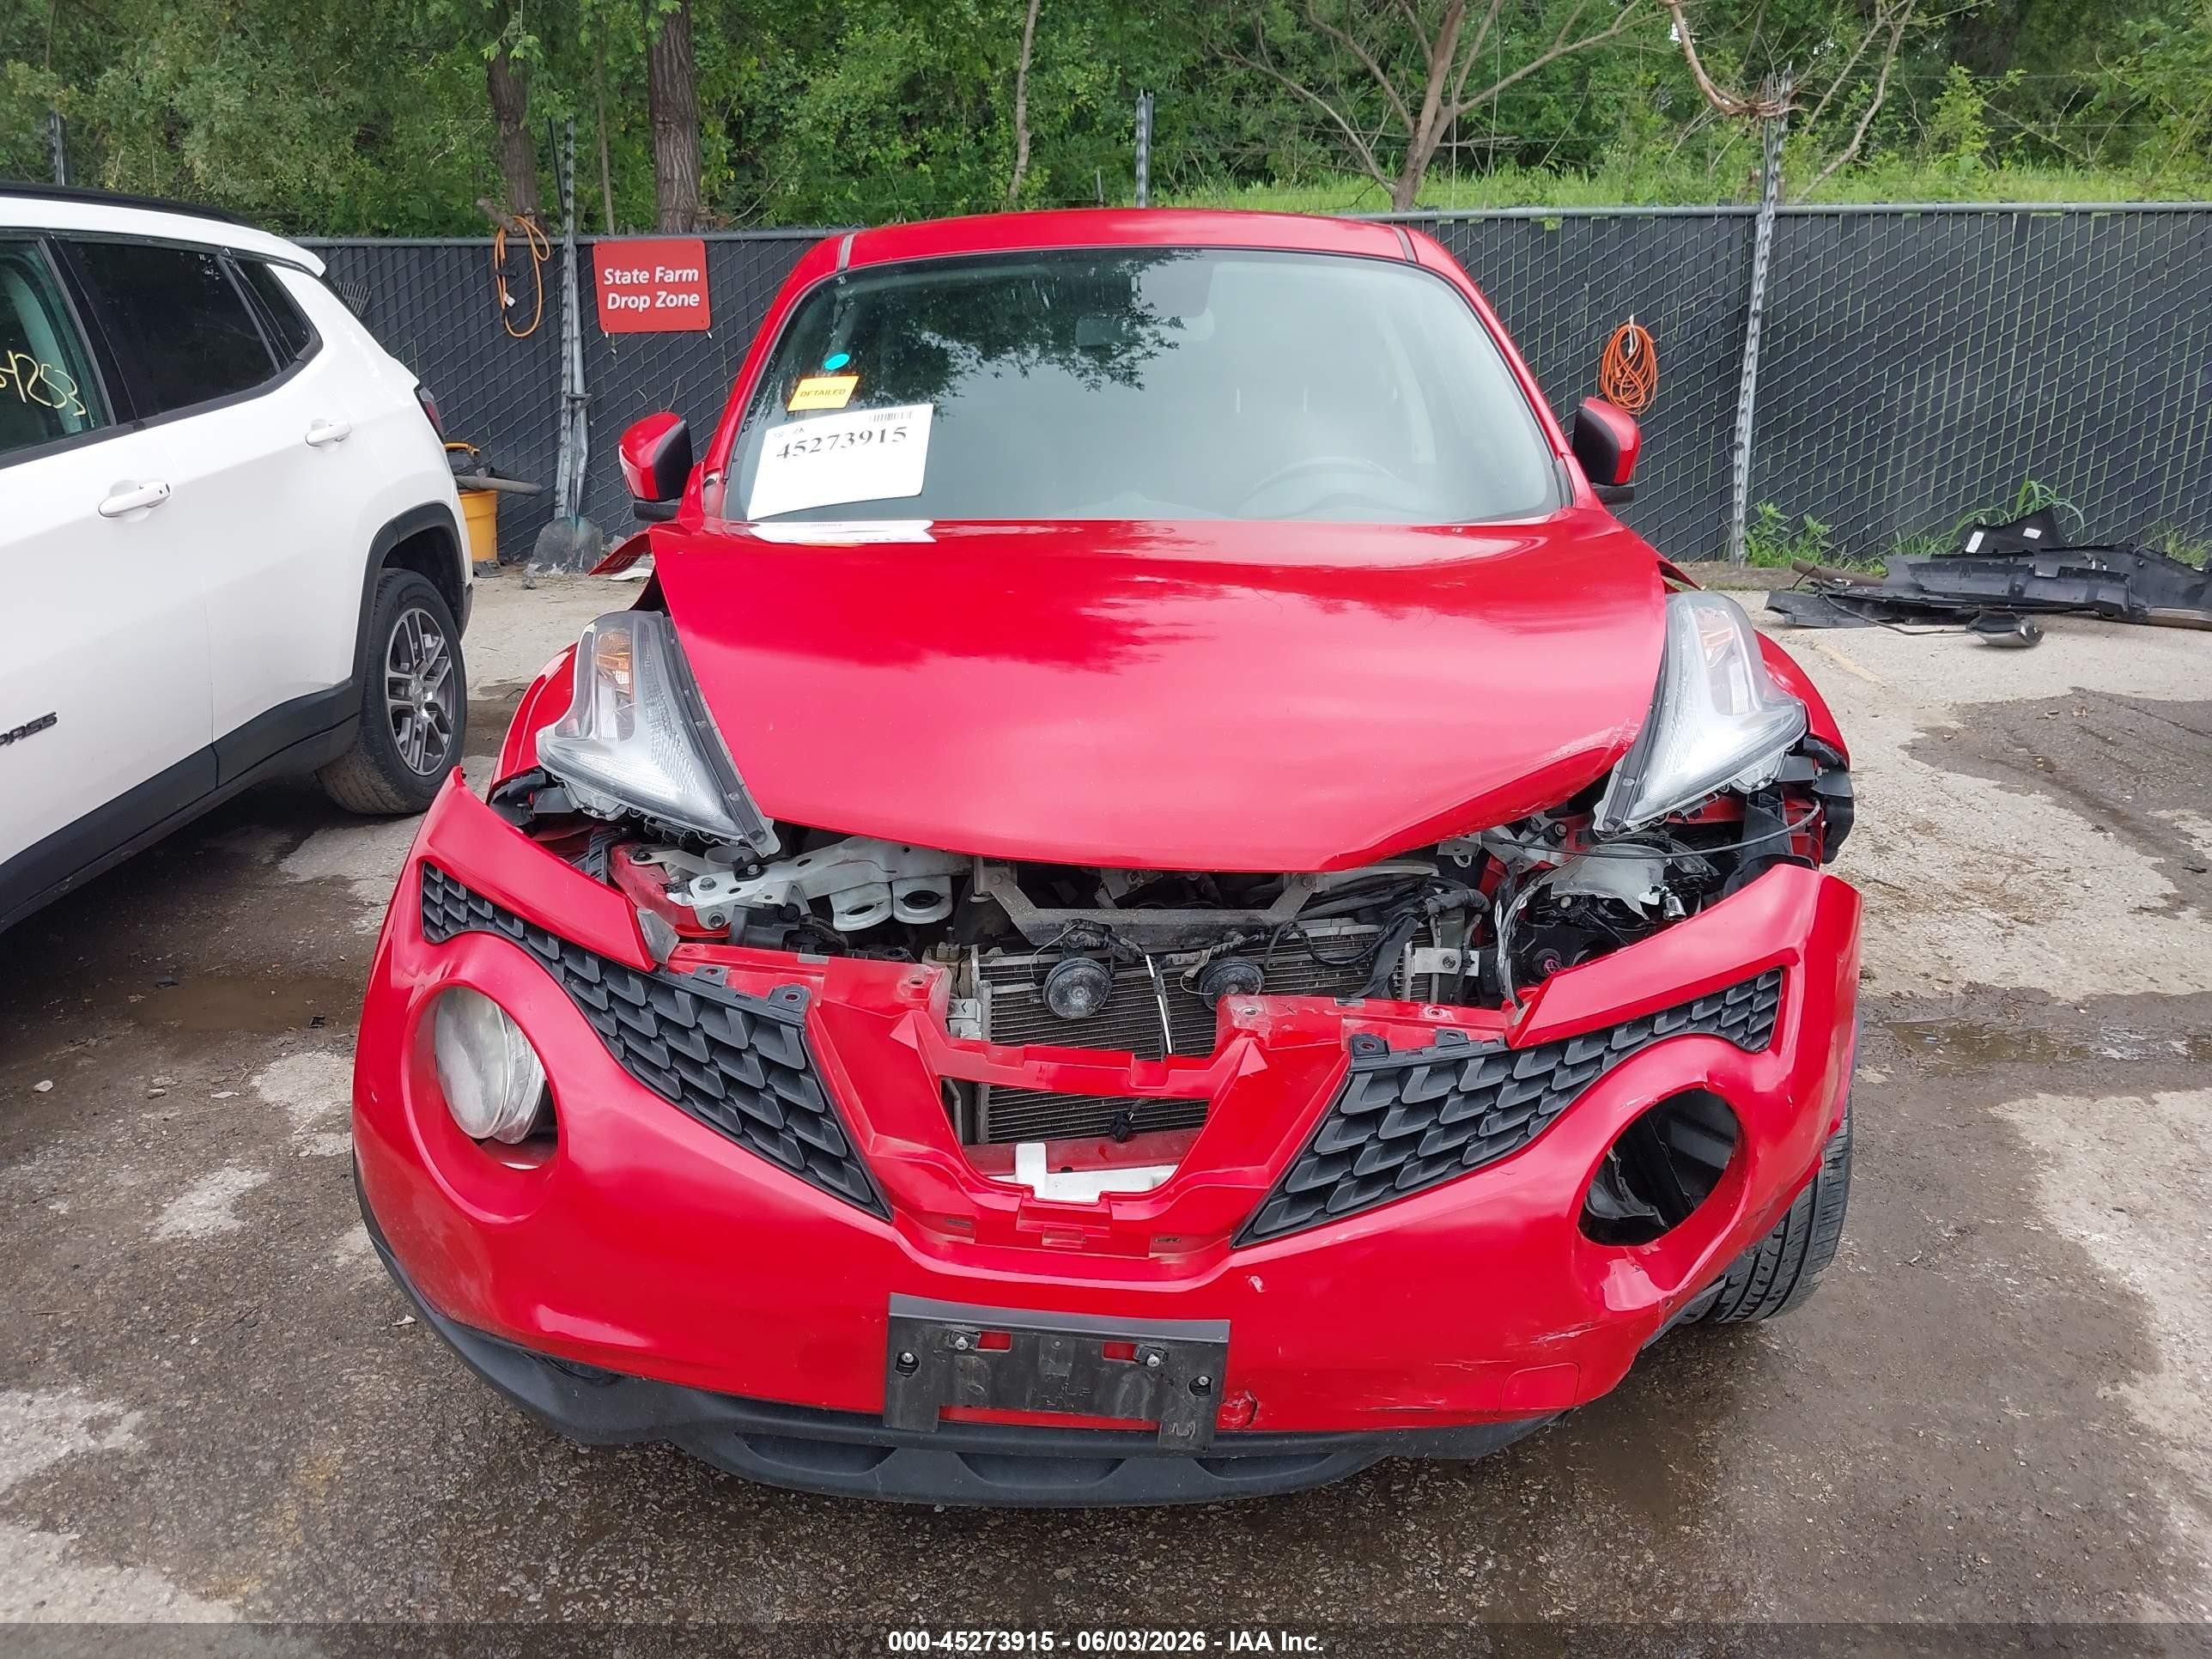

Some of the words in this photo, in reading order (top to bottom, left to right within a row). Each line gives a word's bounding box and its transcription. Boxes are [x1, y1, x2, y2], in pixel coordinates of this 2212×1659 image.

[604, 268, 649, 285] State
[654, 266, 699, 283] Farm
[607, 292, 651, 313] Drop
[655, 290, 700, 308] Zone
[799, 388, 847, 398] DETAILED
[776, 426, 908, 459] 45273915
